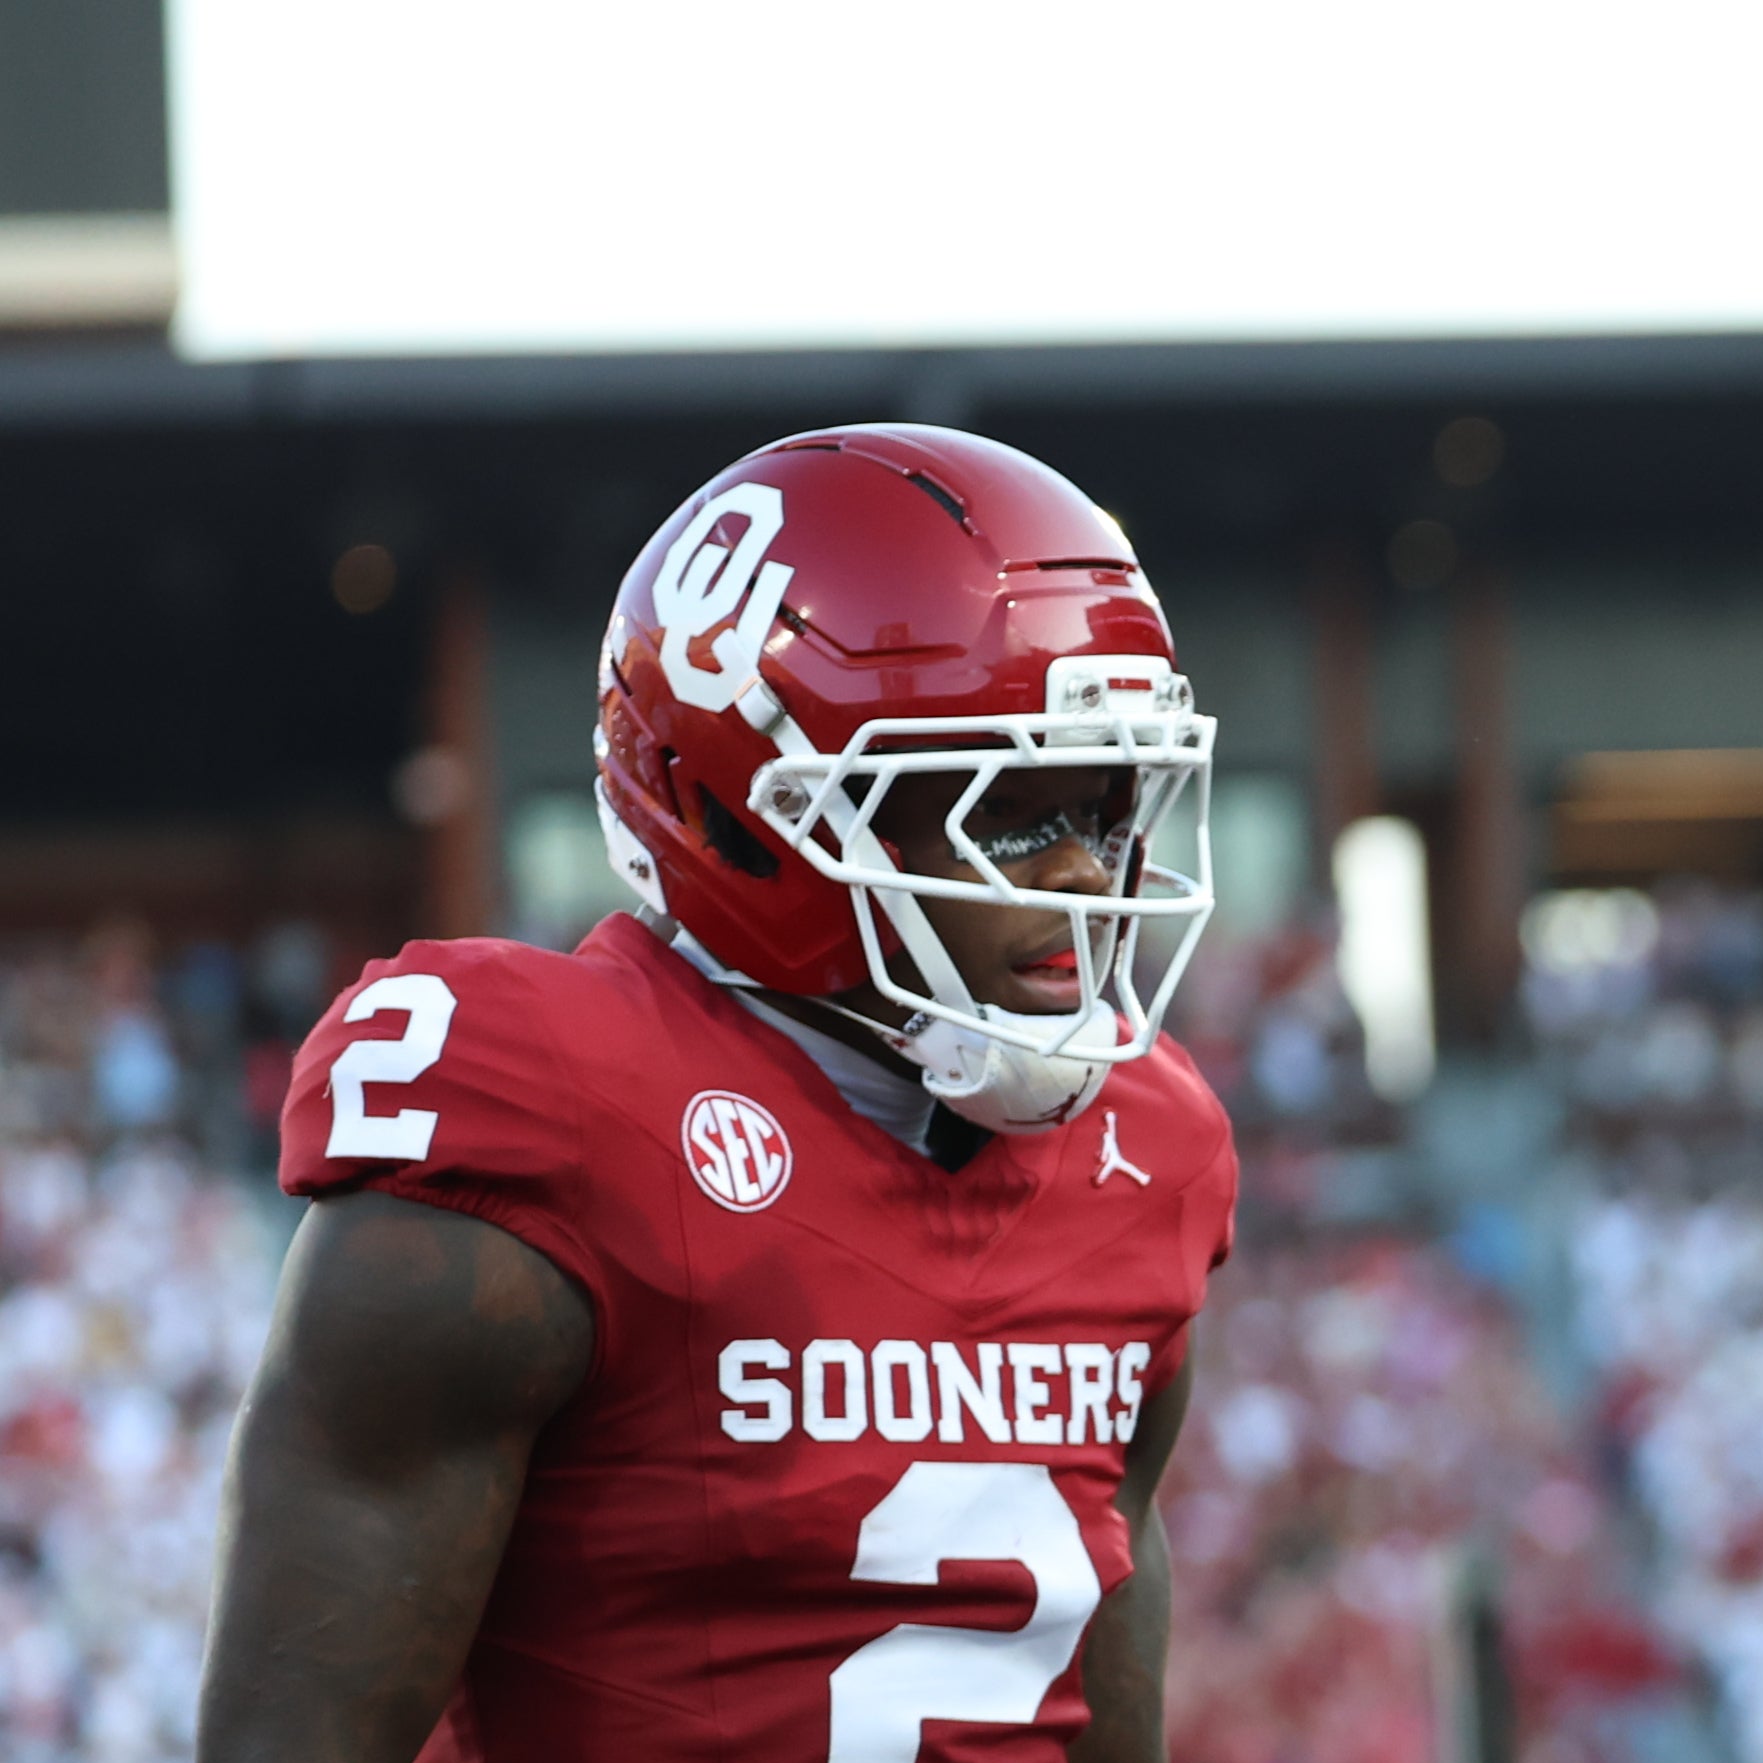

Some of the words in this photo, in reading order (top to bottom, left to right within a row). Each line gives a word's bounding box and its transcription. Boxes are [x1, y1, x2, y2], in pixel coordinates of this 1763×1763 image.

[325, 974, 457, 1161] 2
[689, 1097, 784, 1203] SEC
[718, 1338, 1151, 1445] SOONERS
